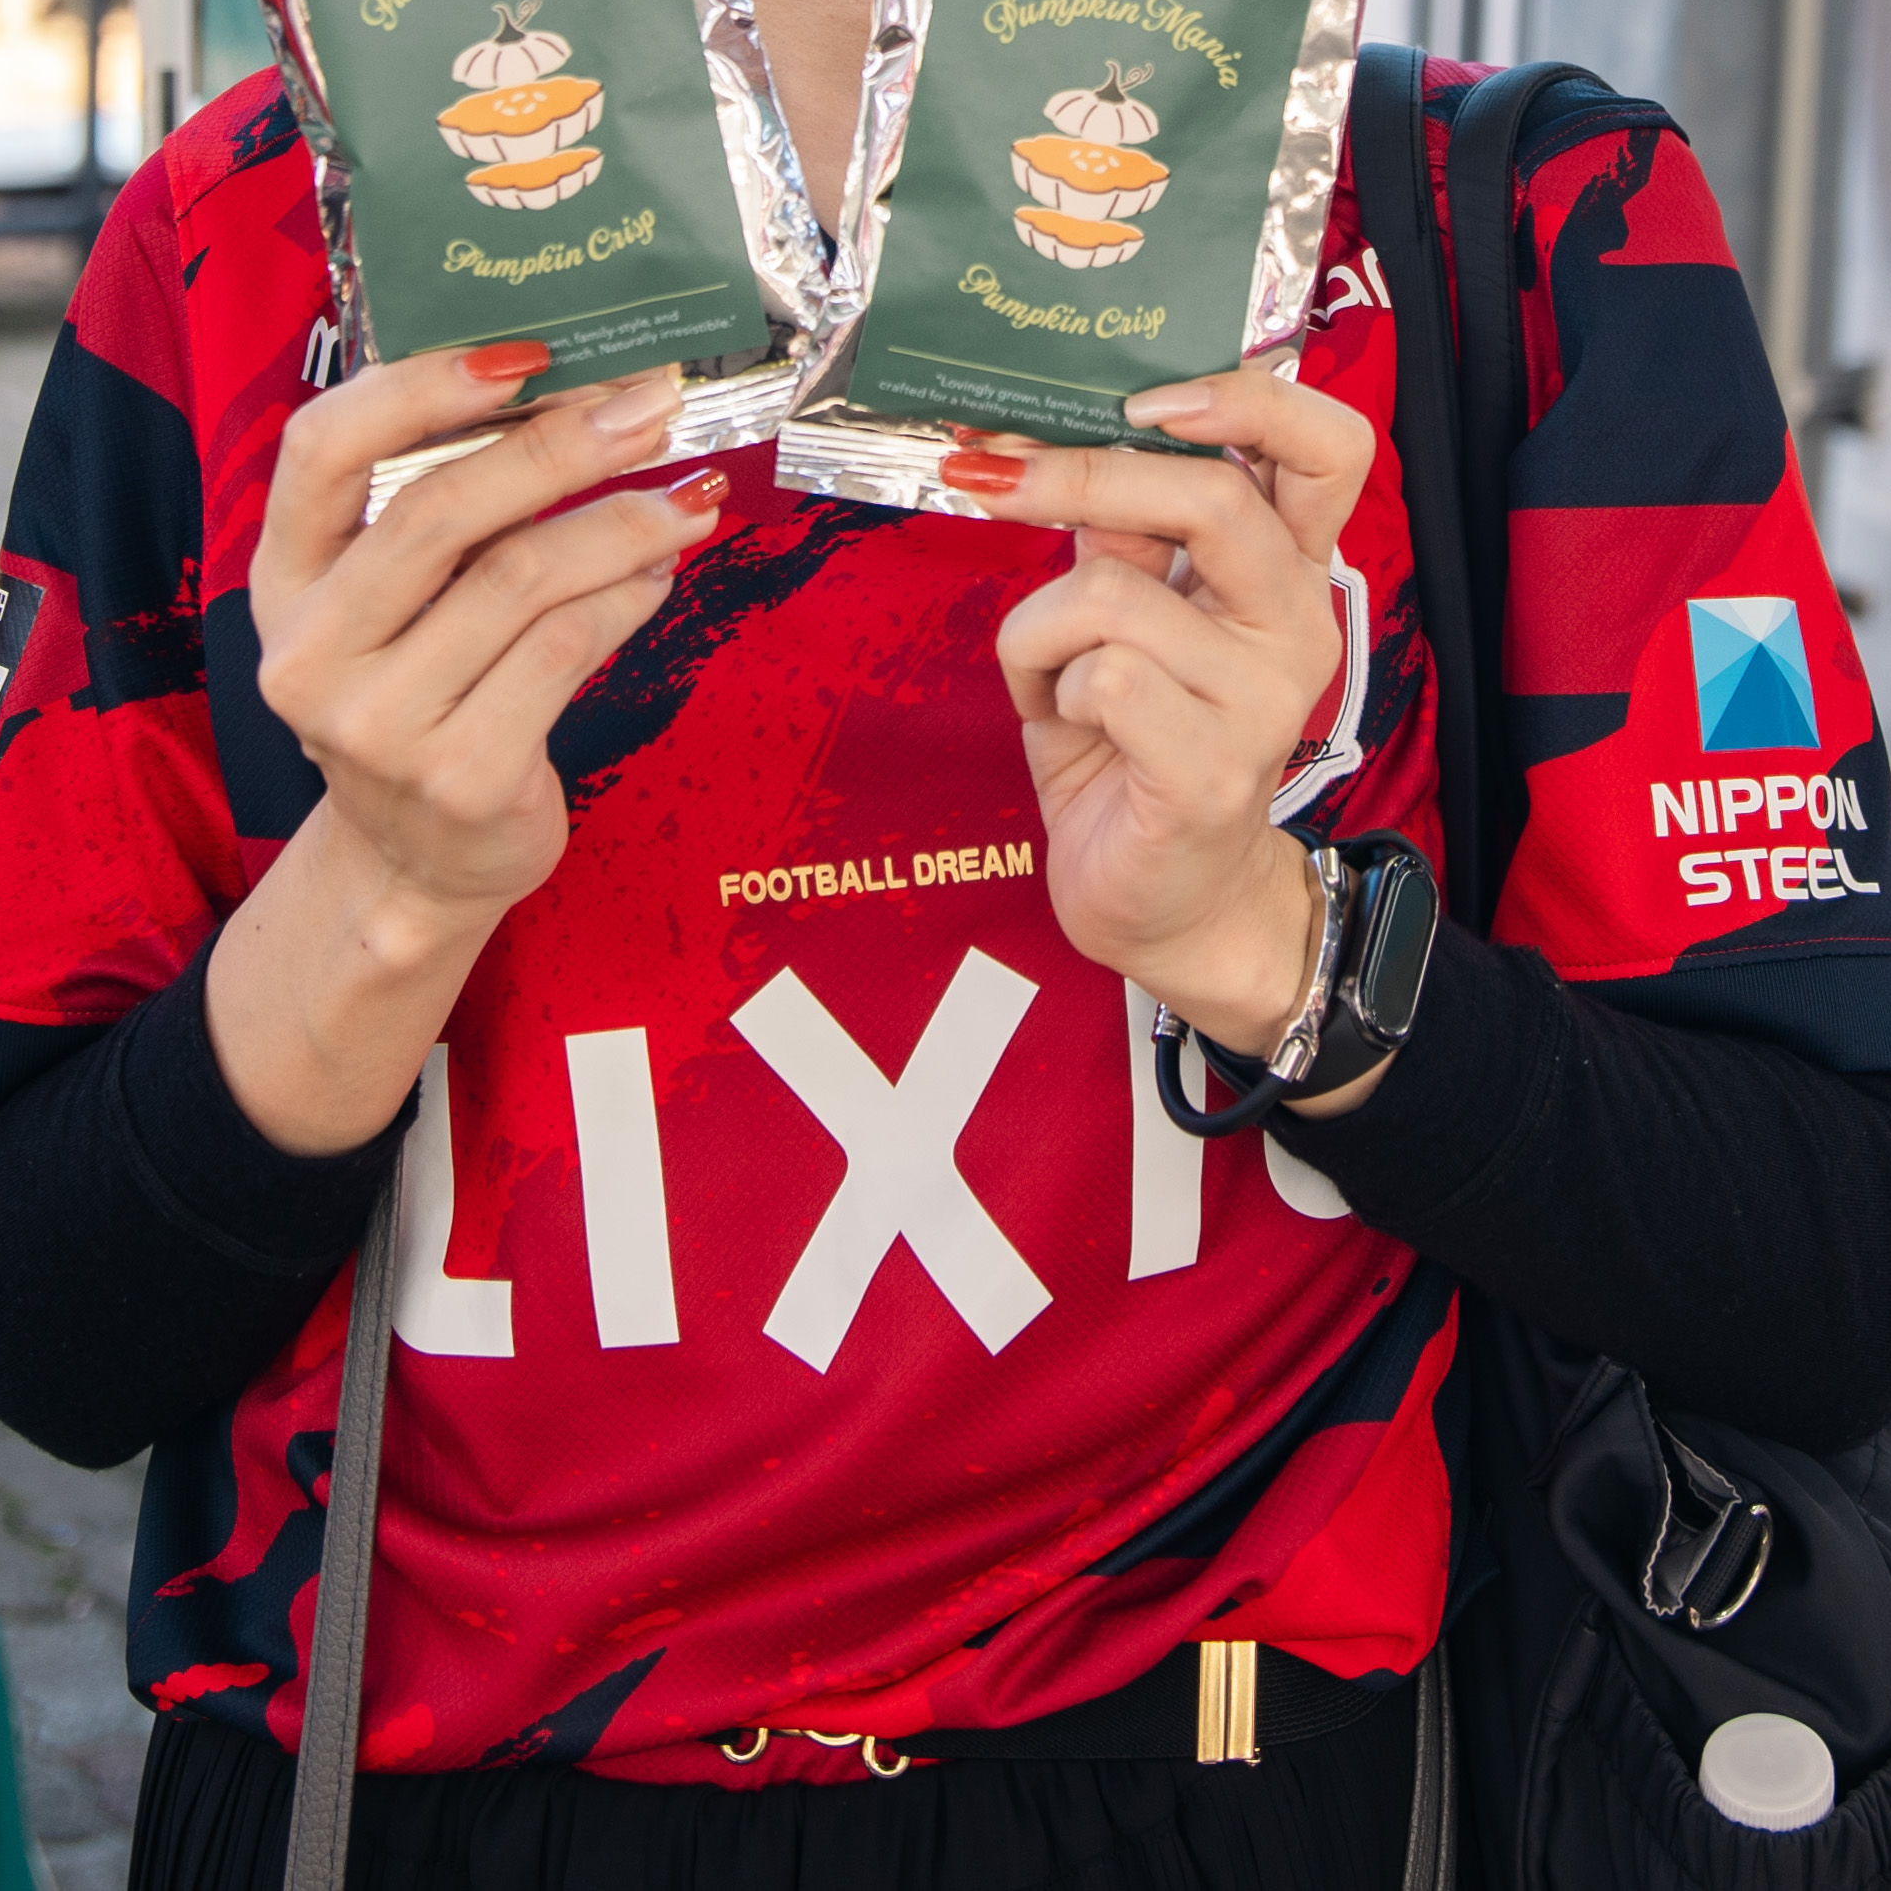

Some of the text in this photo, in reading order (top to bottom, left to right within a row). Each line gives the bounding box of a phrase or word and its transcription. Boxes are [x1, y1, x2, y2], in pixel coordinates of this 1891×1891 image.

[443, 207, 657, 287] Pumpkin Crisp
[654, 310, 680, 325] and
[959, 263, 1166, 340] Pumpkin Crisp
[598, 331, 659, 355] Naturally
[878, 380, 926, 399] crafted
[929, 389, 947, 403] for
[961, 395, 1008, 417] healthy
[1011, 408, 1058, 426] crunch.
[1062, 418, 1121, 440] Naturally
[1651, 773, 1868, 838] NIPPON
[719, 840, 1034, 908] FOOTBALL DREAM
[1679, 845, 1881, 906] STEEL
[389, 945, 1354, 1377] LIXI
